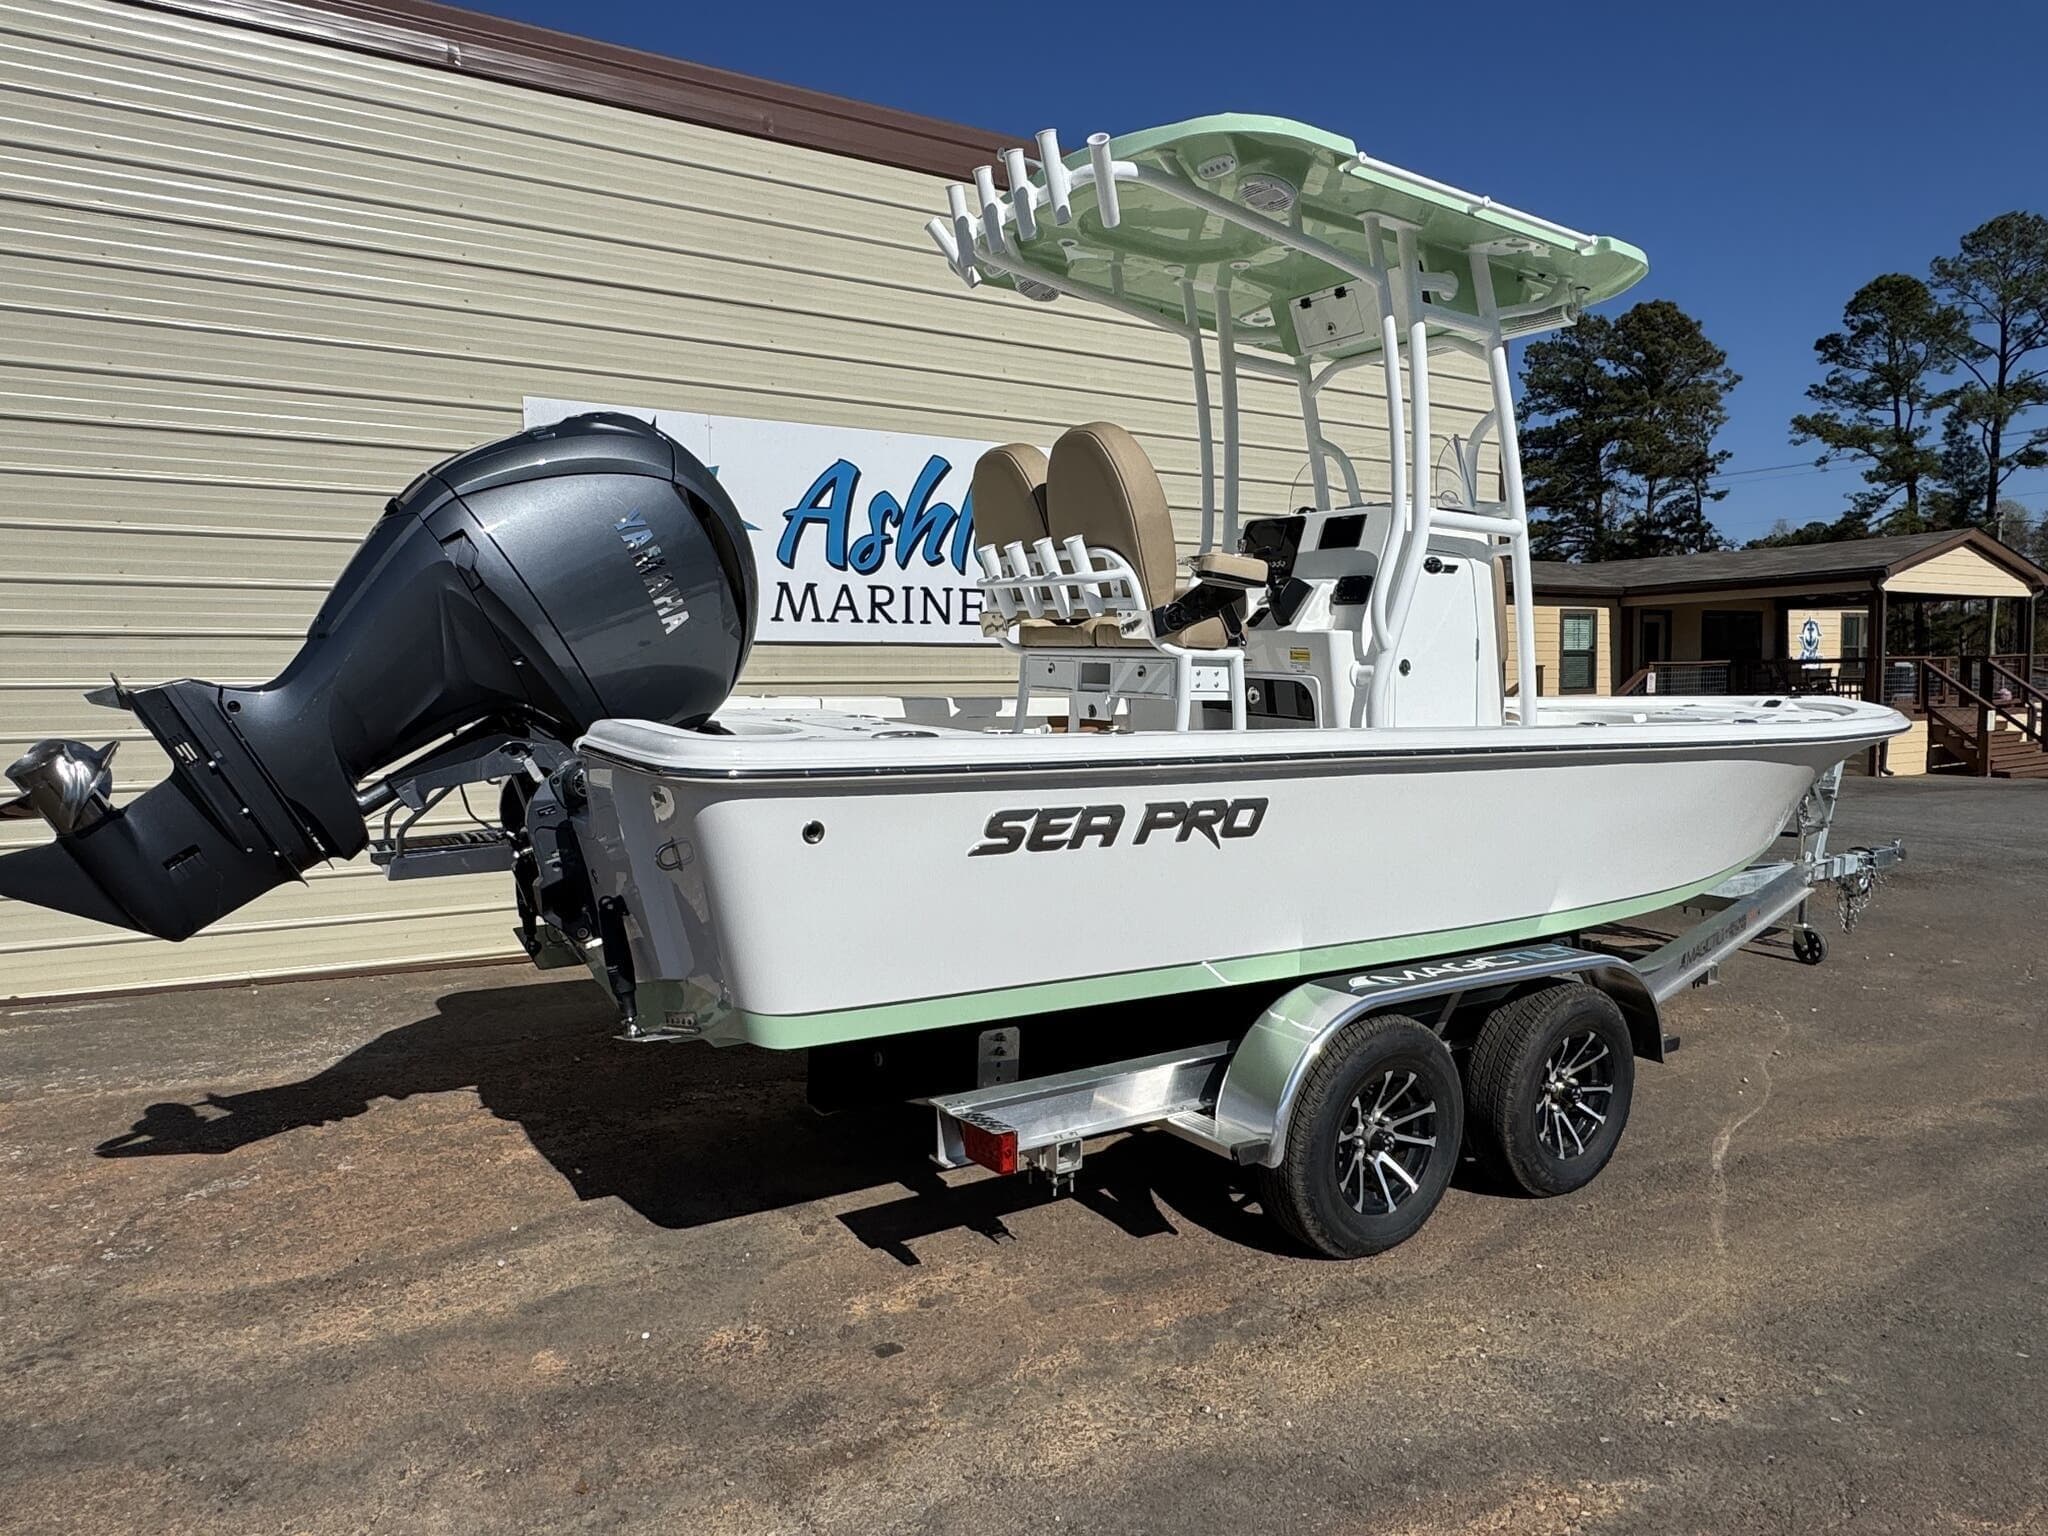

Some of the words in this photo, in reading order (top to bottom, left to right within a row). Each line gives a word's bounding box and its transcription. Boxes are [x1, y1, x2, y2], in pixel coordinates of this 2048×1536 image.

[776, 454, 984, 576] Ashl
[614, 504, 690, 635] YAMAHA
[770, 582, 986, 625] MARINE
[967, 804, 1126, 857] SEA
[1132, 797, 1269, 850] PRO
